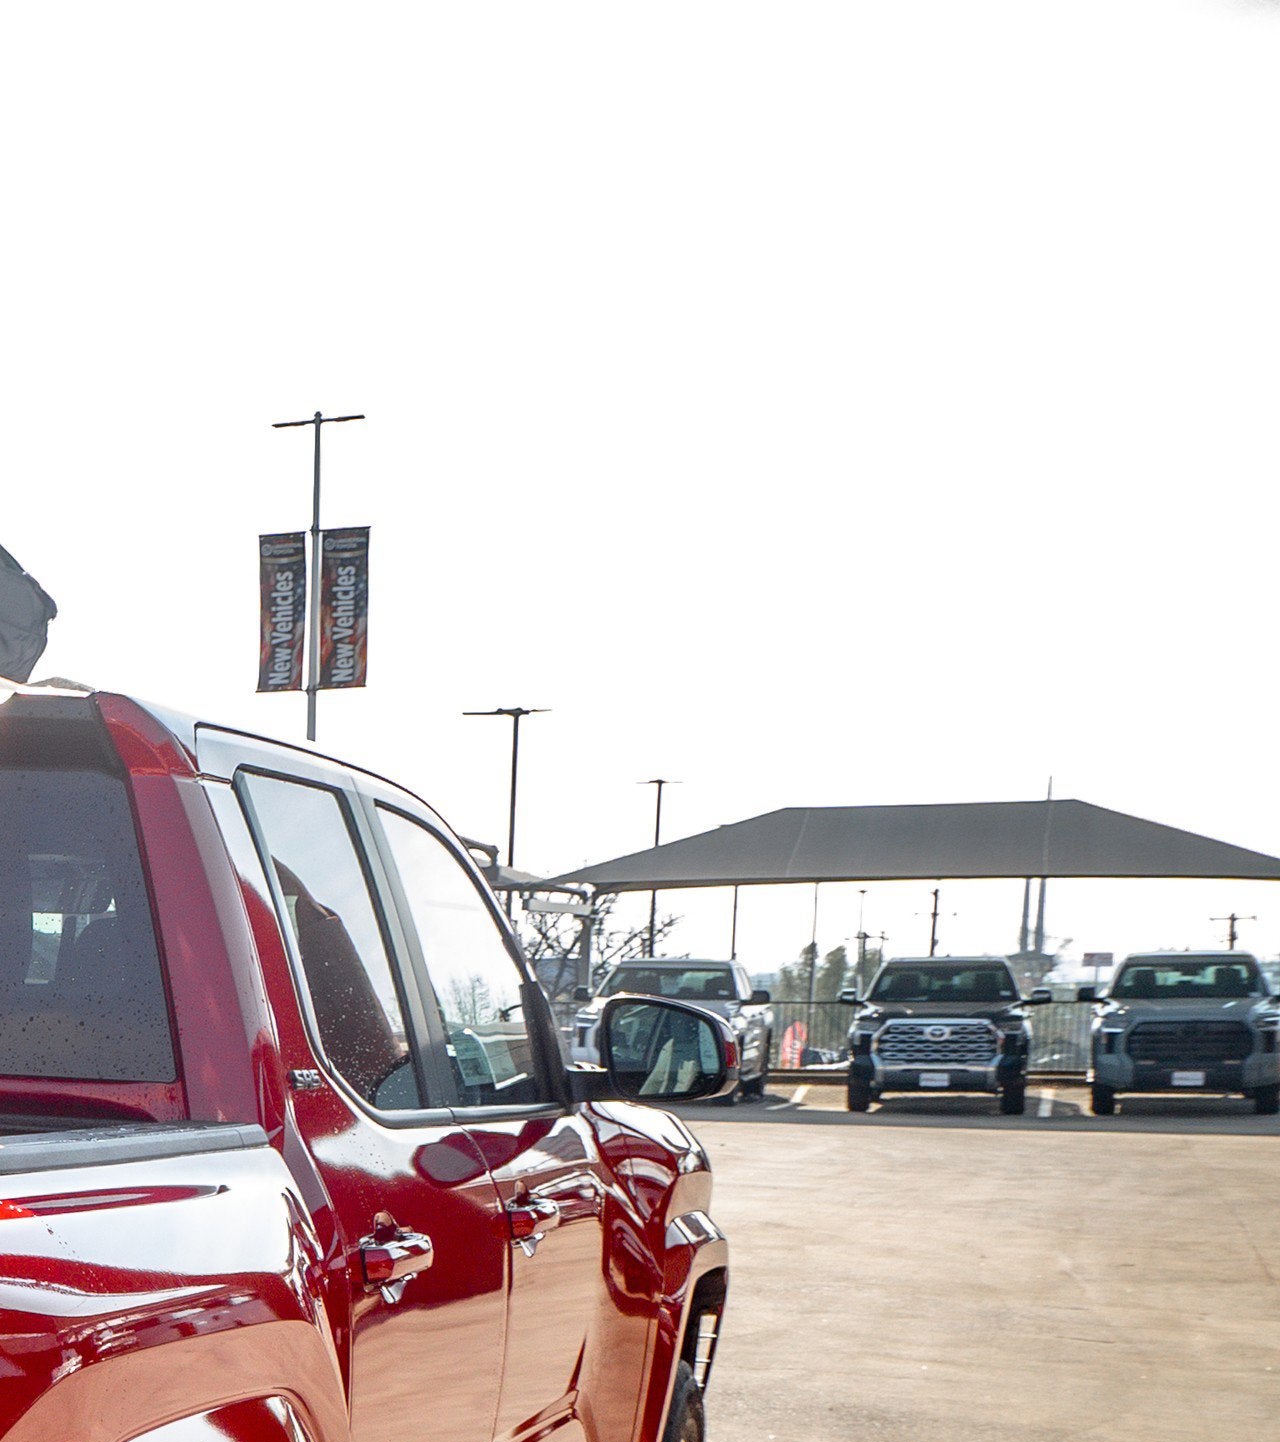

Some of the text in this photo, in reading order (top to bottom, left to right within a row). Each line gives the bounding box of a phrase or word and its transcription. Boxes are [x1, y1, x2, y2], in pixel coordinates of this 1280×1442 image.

[271, 570, 294, 646] Vehicles
[331, 565, 356, 642] Vehicles
[269, 648, 291, 686] New
[331, 643, 354, 683] New
